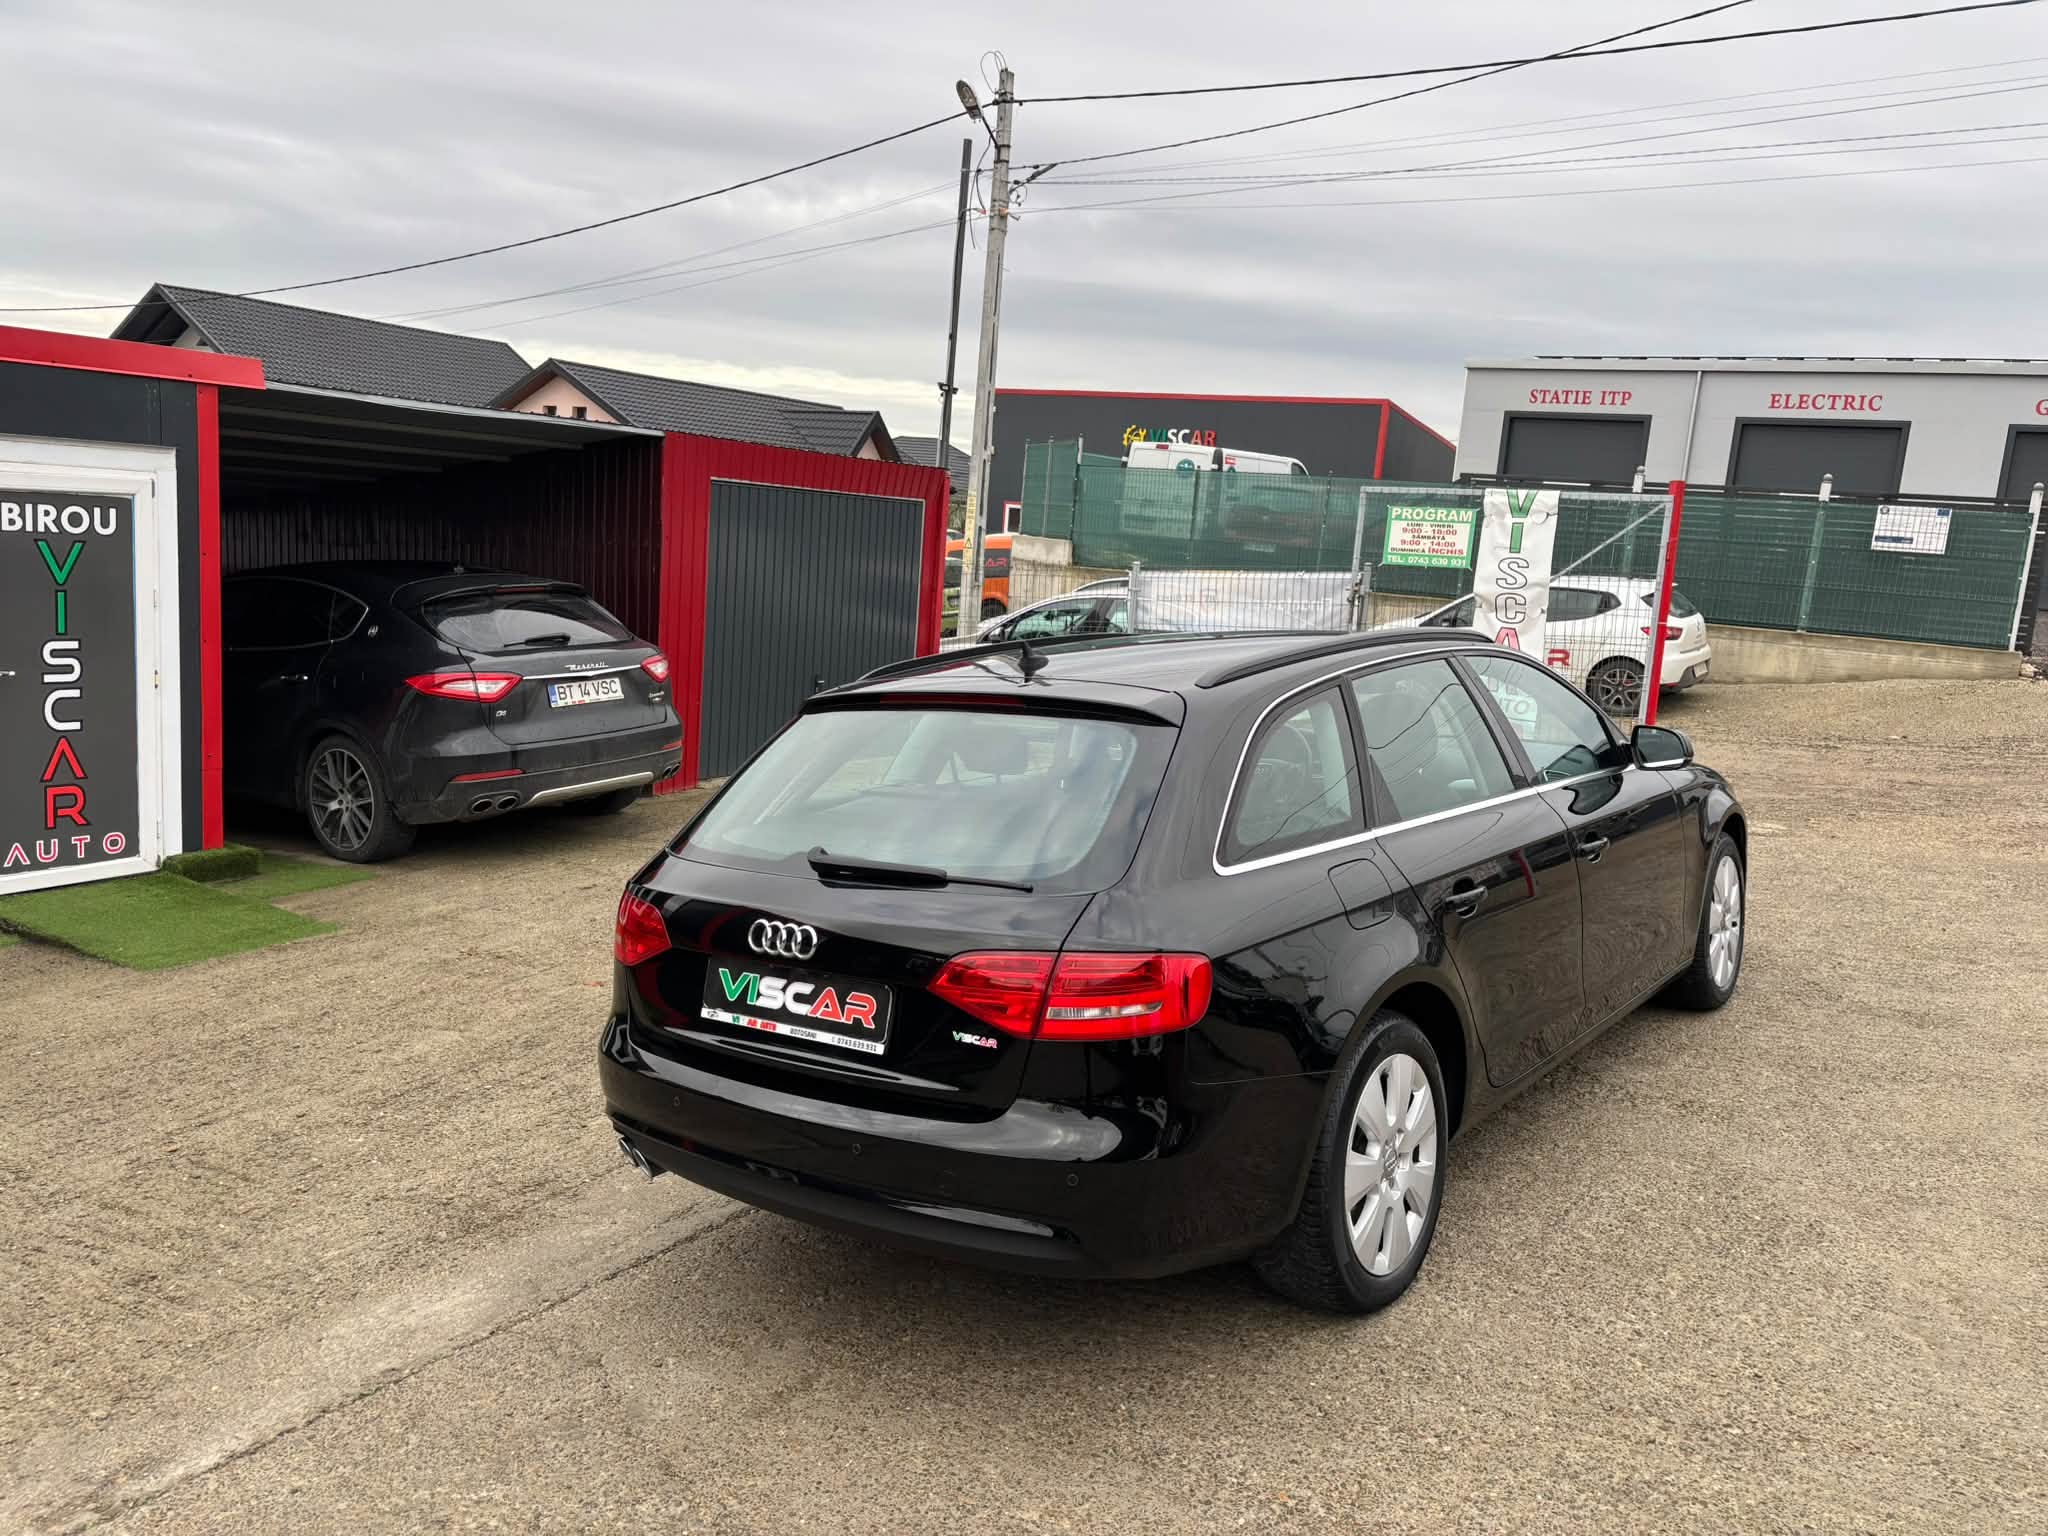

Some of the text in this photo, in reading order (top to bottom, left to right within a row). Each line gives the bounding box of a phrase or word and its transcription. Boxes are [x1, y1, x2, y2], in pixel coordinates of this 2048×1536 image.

[1528, 388, 1633, 406] STATIE ITP
[1768, 393, 1883, 412] ELECTRIC
[1150, 428, 1217, 447] VISCAR
[0, 502, 118, 536] BIROU
[1391, 507, 1473, 522] PROGRAM
[34, 538, 91, 830] VISCAR
[557, 679, 619, 701] BT 14 VSC
[3, 831, 127, 868] AUTO
[718, 967, 877, 1030] VISCAR
[952, 1030, 998, 1049] VISCAR
